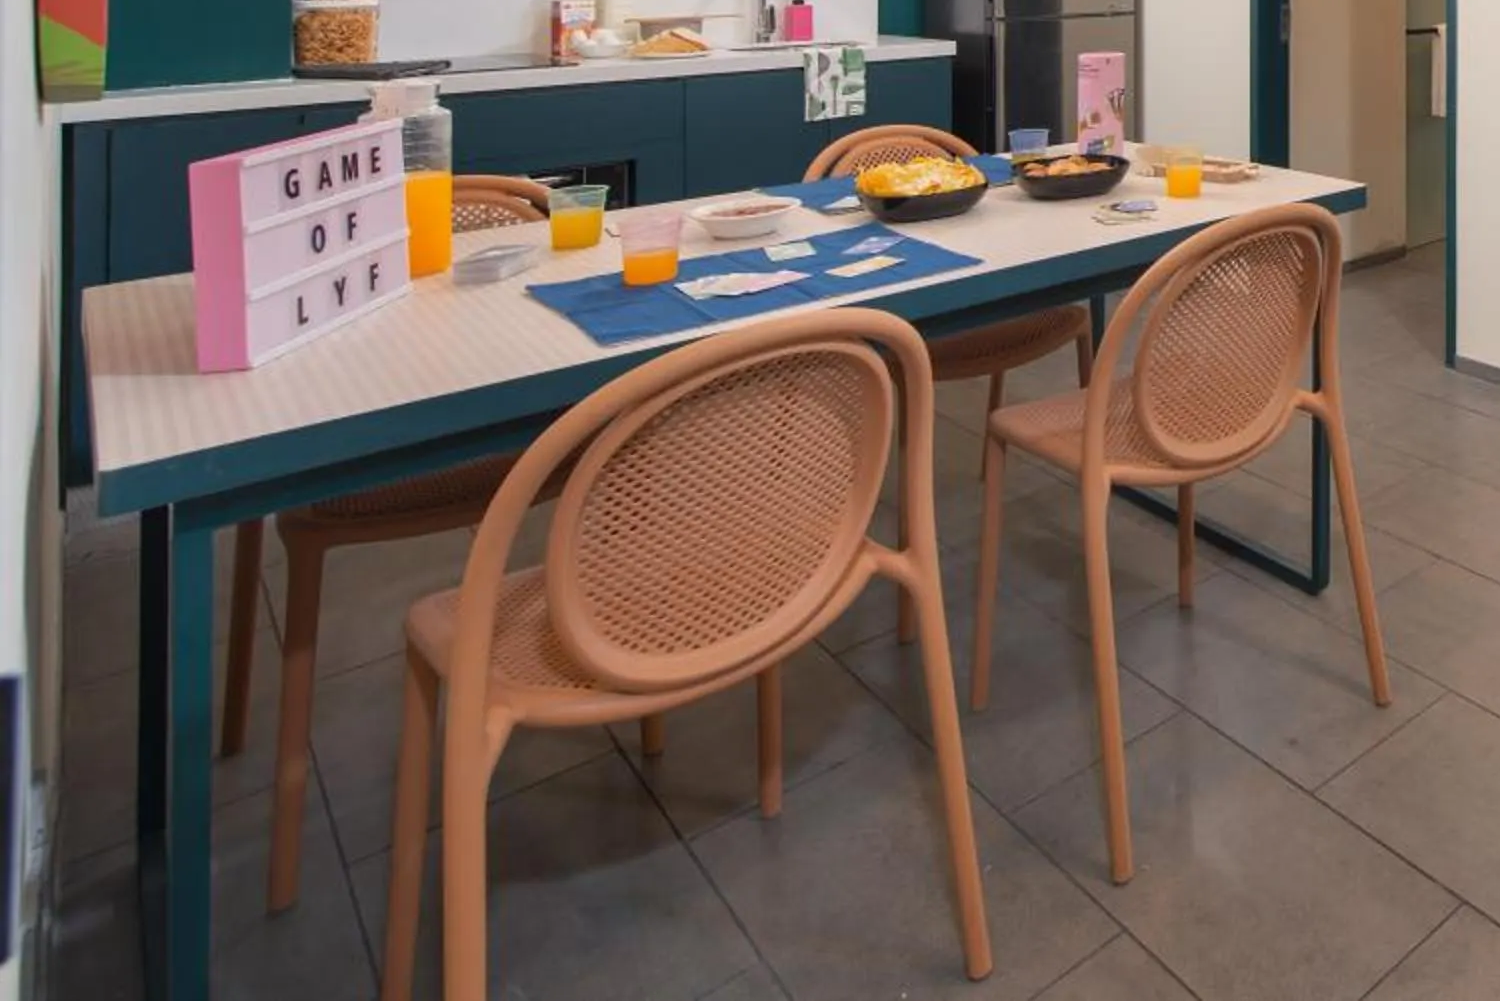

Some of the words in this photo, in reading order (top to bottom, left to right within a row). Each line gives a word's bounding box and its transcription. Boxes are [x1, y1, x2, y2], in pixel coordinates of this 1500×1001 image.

[284, 146, 382, 199] GAME
[311, 212, 357, 254] OF
[297, 263, 379, 326] LYF
